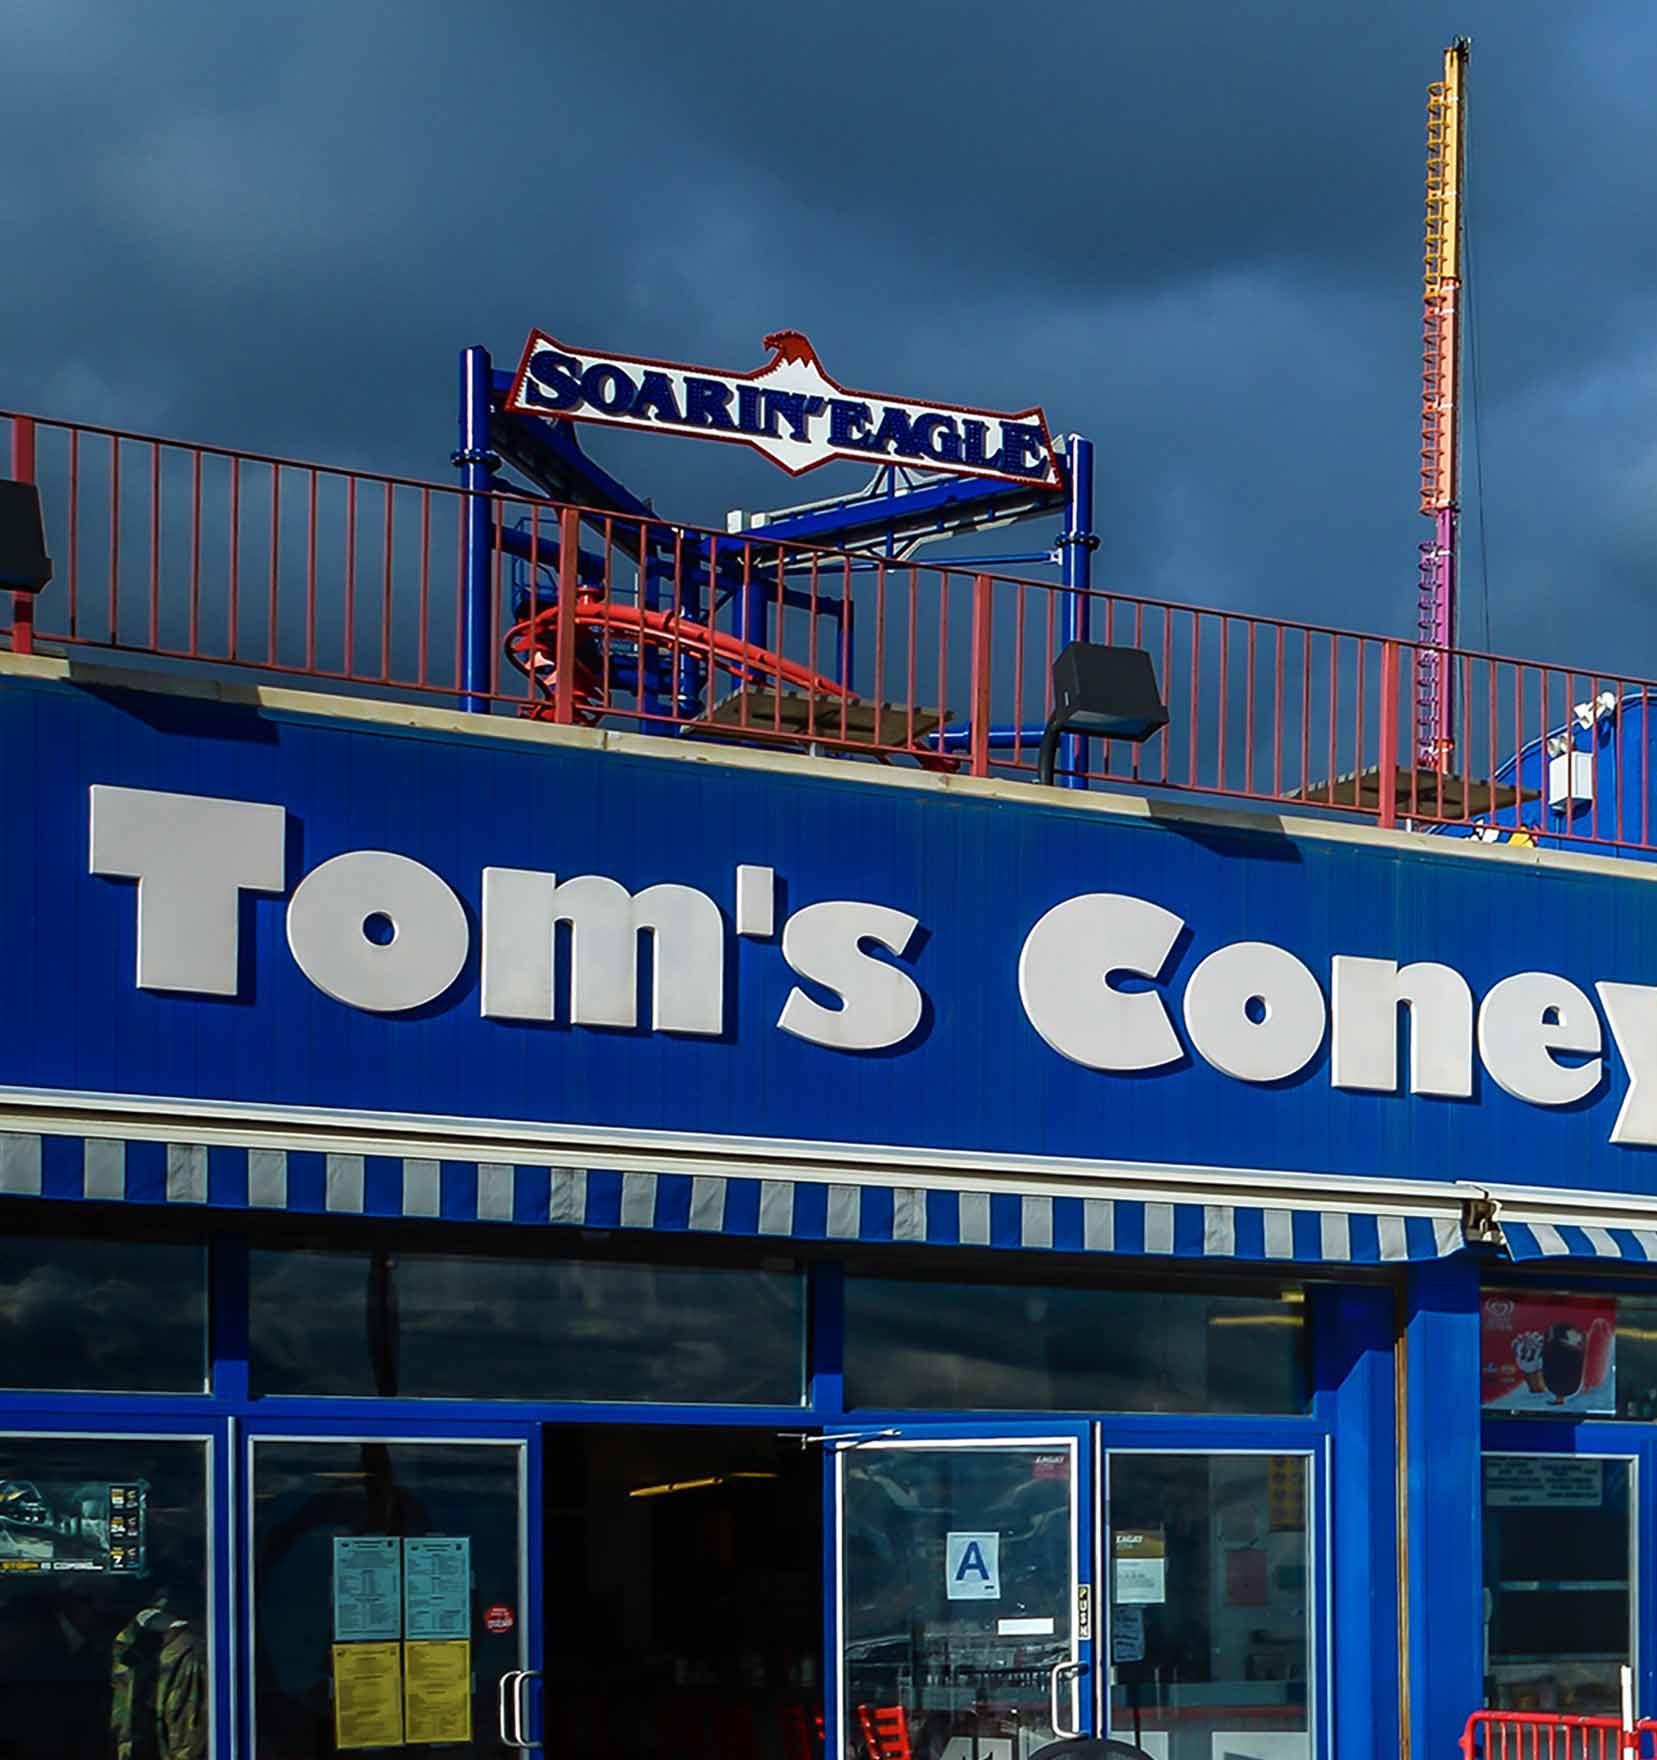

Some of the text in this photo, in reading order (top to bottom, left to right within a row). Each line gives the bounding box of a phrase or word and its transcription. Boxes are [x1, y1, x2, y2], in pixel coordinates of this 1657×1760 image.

[827, 397, 1052, 476] EAGLE
[90, 784, 922, 1051] Tom's
[955, 1540, 990, 1581] A
